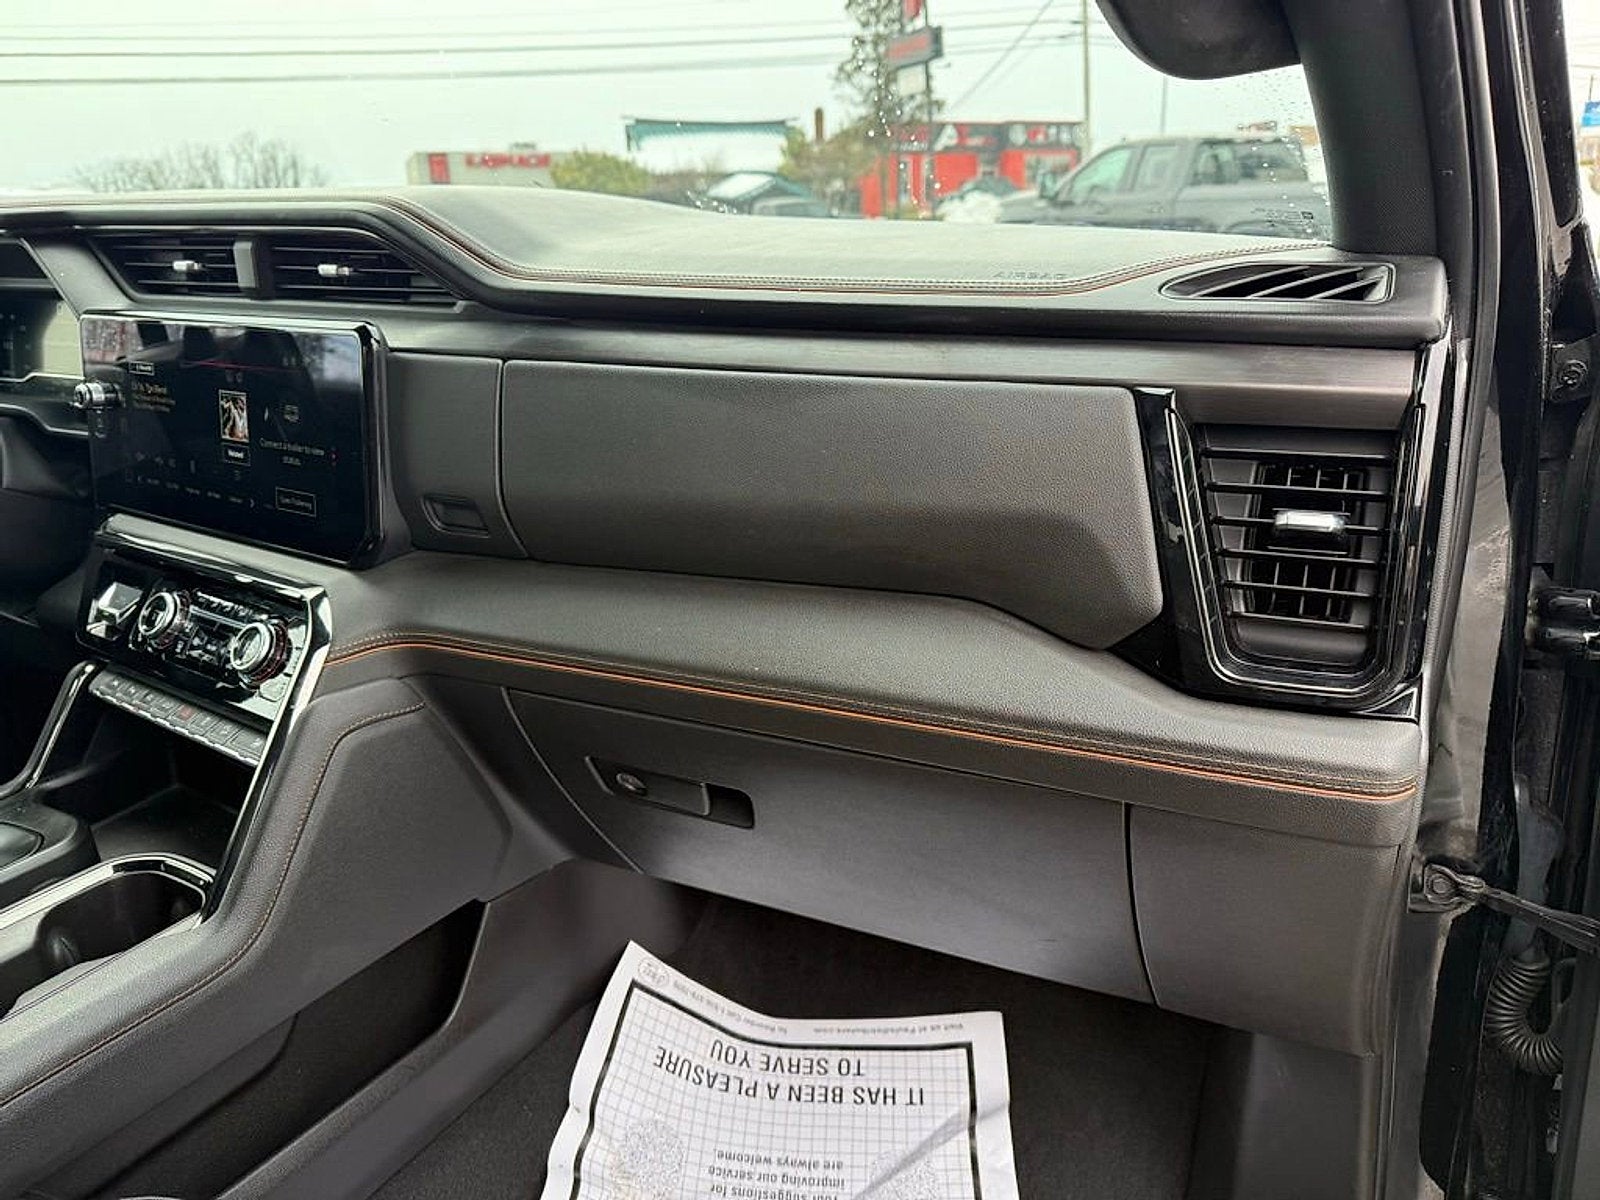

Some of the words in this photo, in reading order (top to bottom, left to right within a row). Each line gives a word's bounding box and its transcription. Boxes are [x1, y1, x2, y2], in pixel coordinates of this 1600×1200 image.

[710, 1039, 750, 1068] YOU
[653, 1046, 758, 1098] PLEASURE
[759, 1053, 829, 1076] SERVE
[837, 1058, 865, 1076] TO
[767, 1082, 780, 1099] A
[788, 1083, 843, 1104] BEEN
[853, 1086, 896, 1106] HAS
[905, 1087, 924, 1106] IT
[777, 1155, 820, 1171] always
[823, 1160, 843, 1170] are
[708, 1165, 753, 1181] service
[756, 1172, 778, 1183] our
[781, 1173, 845, 1190] improving
[710, 1184, 727, 1197] for
